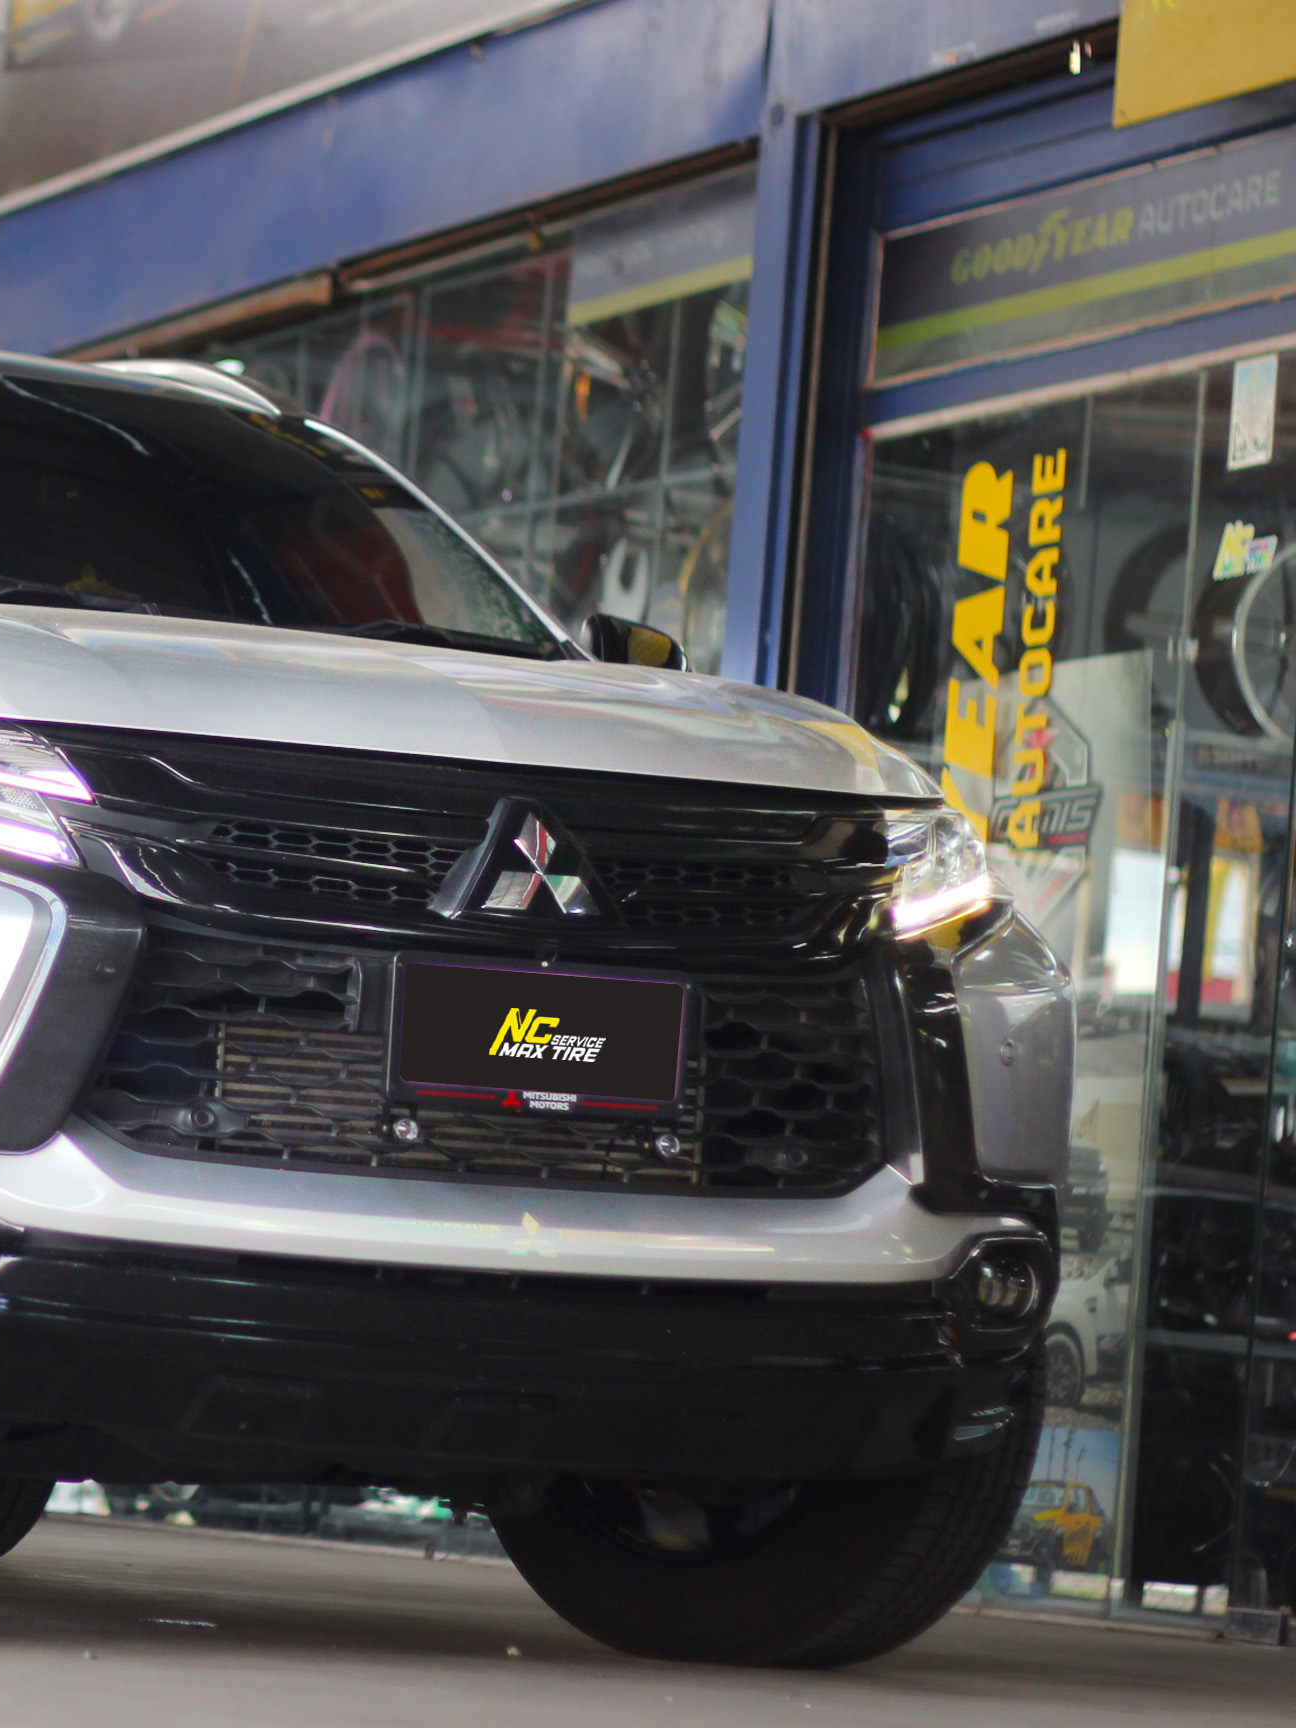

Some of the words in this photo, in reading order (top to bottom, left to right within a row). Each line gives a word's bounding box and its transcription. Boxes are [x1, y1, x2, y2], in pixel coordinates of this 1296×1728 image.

[951, 208, 1135, 285] GOODYEAR
[1138, 169, 1282, 238] AUTOCARE
[1007, 447, 1067, 850] AUTOCARE
[522, 1090, 577, 1102] MITSUBISHI
[529, 1100, 570, 1111] MOTORS
